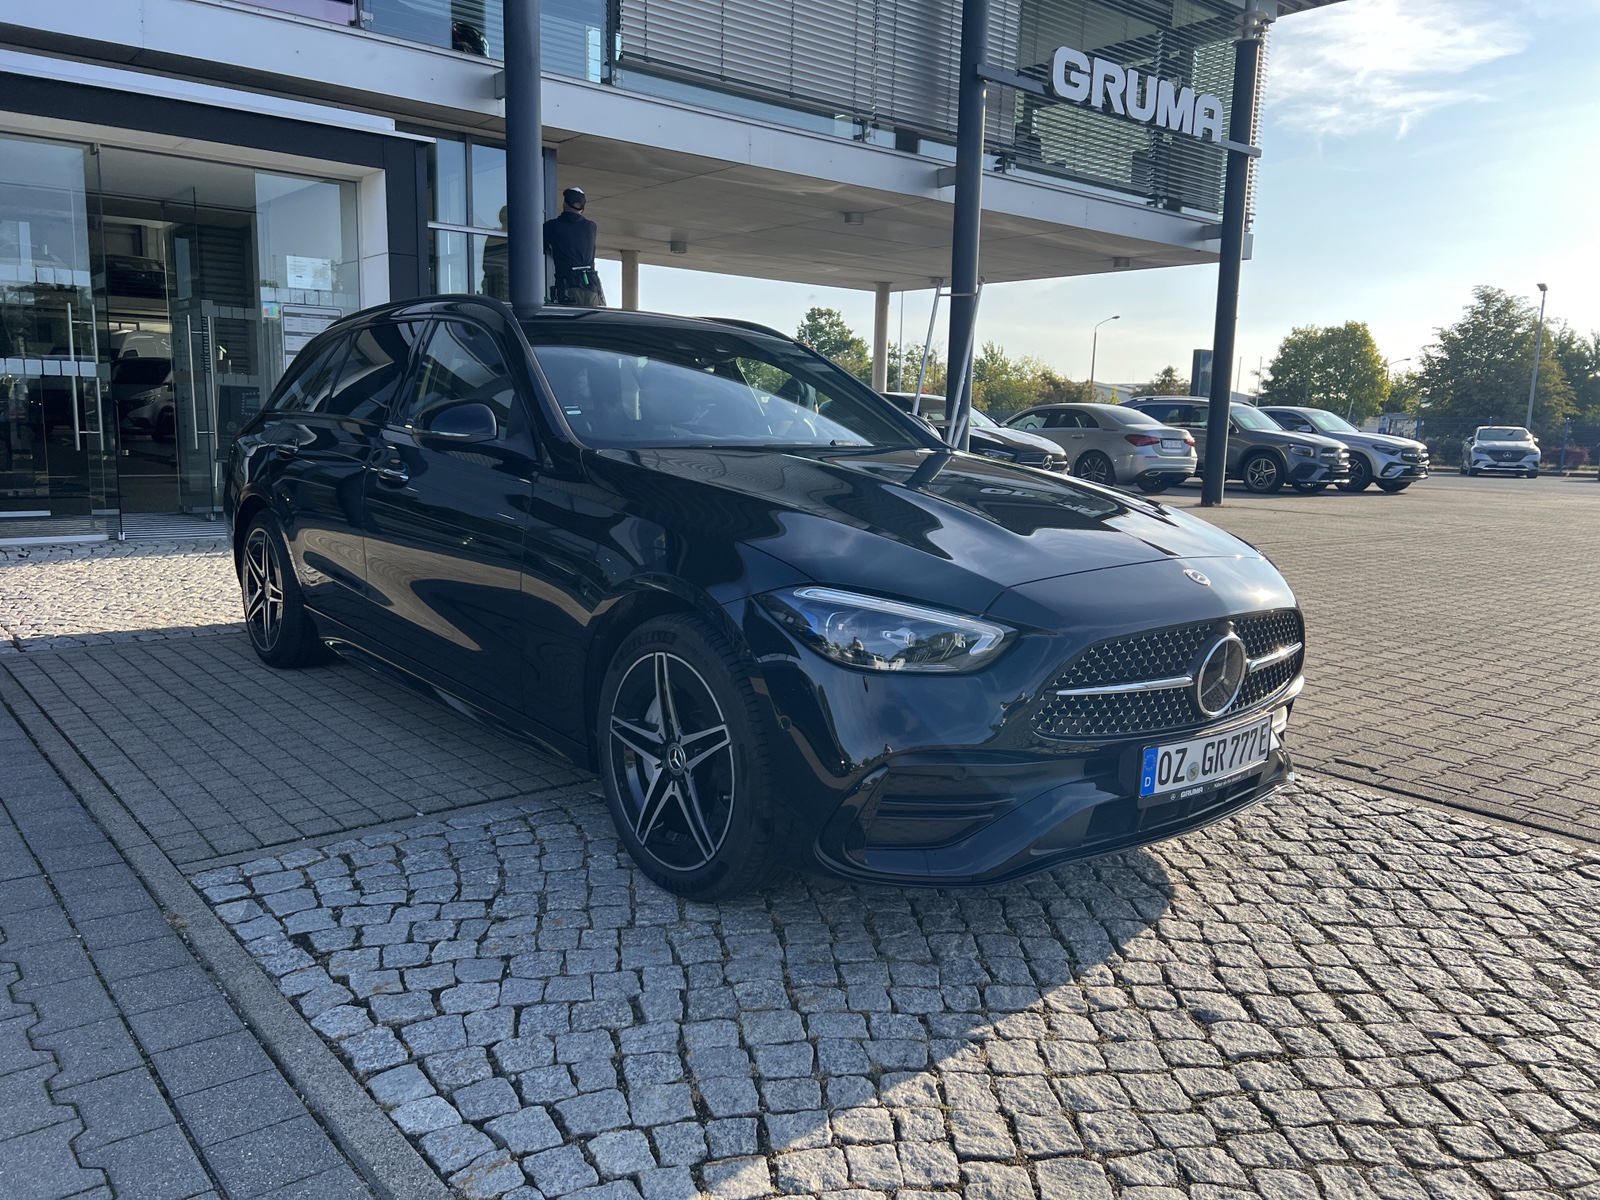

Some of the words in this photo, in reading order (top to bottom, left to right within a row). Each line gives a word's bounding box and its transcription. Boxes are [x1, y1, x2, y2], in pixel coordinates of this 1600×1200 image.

[1052, 46, 1223, 142] GRUMA
[1158, 747, 1188, 786] OZ
[1144, 776, 1151, 788] D
[1180, 786, 1204, 798] GRUMA
